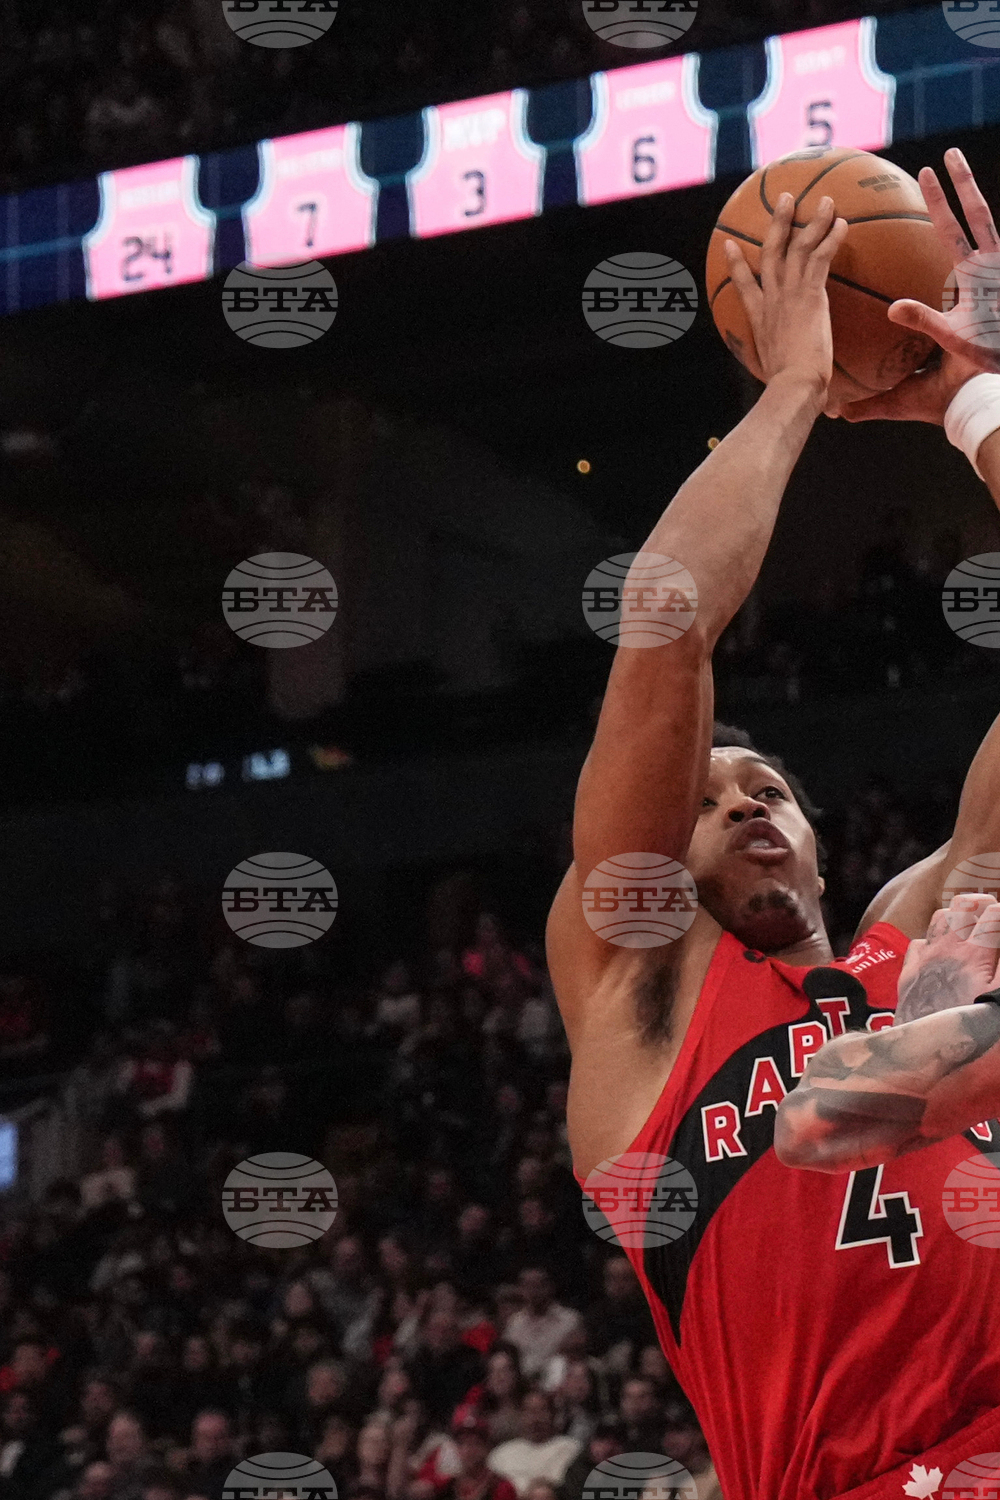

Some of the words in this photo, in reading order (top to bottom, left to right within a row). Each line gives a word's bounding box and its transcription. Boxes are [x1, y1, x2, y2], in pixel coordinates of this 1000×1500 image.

[807, 100, 834, 147] 5
[632, 135, 657, 183] 6
[463, 170, 486, 217] 3
[296, 202, 318, 247] 7
[122, 231, 173, 283] 24
[852, 961, 871, 973] un
[867, 949, 896, 963] Life
[701, 997, 992, 1162] RAPT
[835, 1163, 924, 1269] 4
